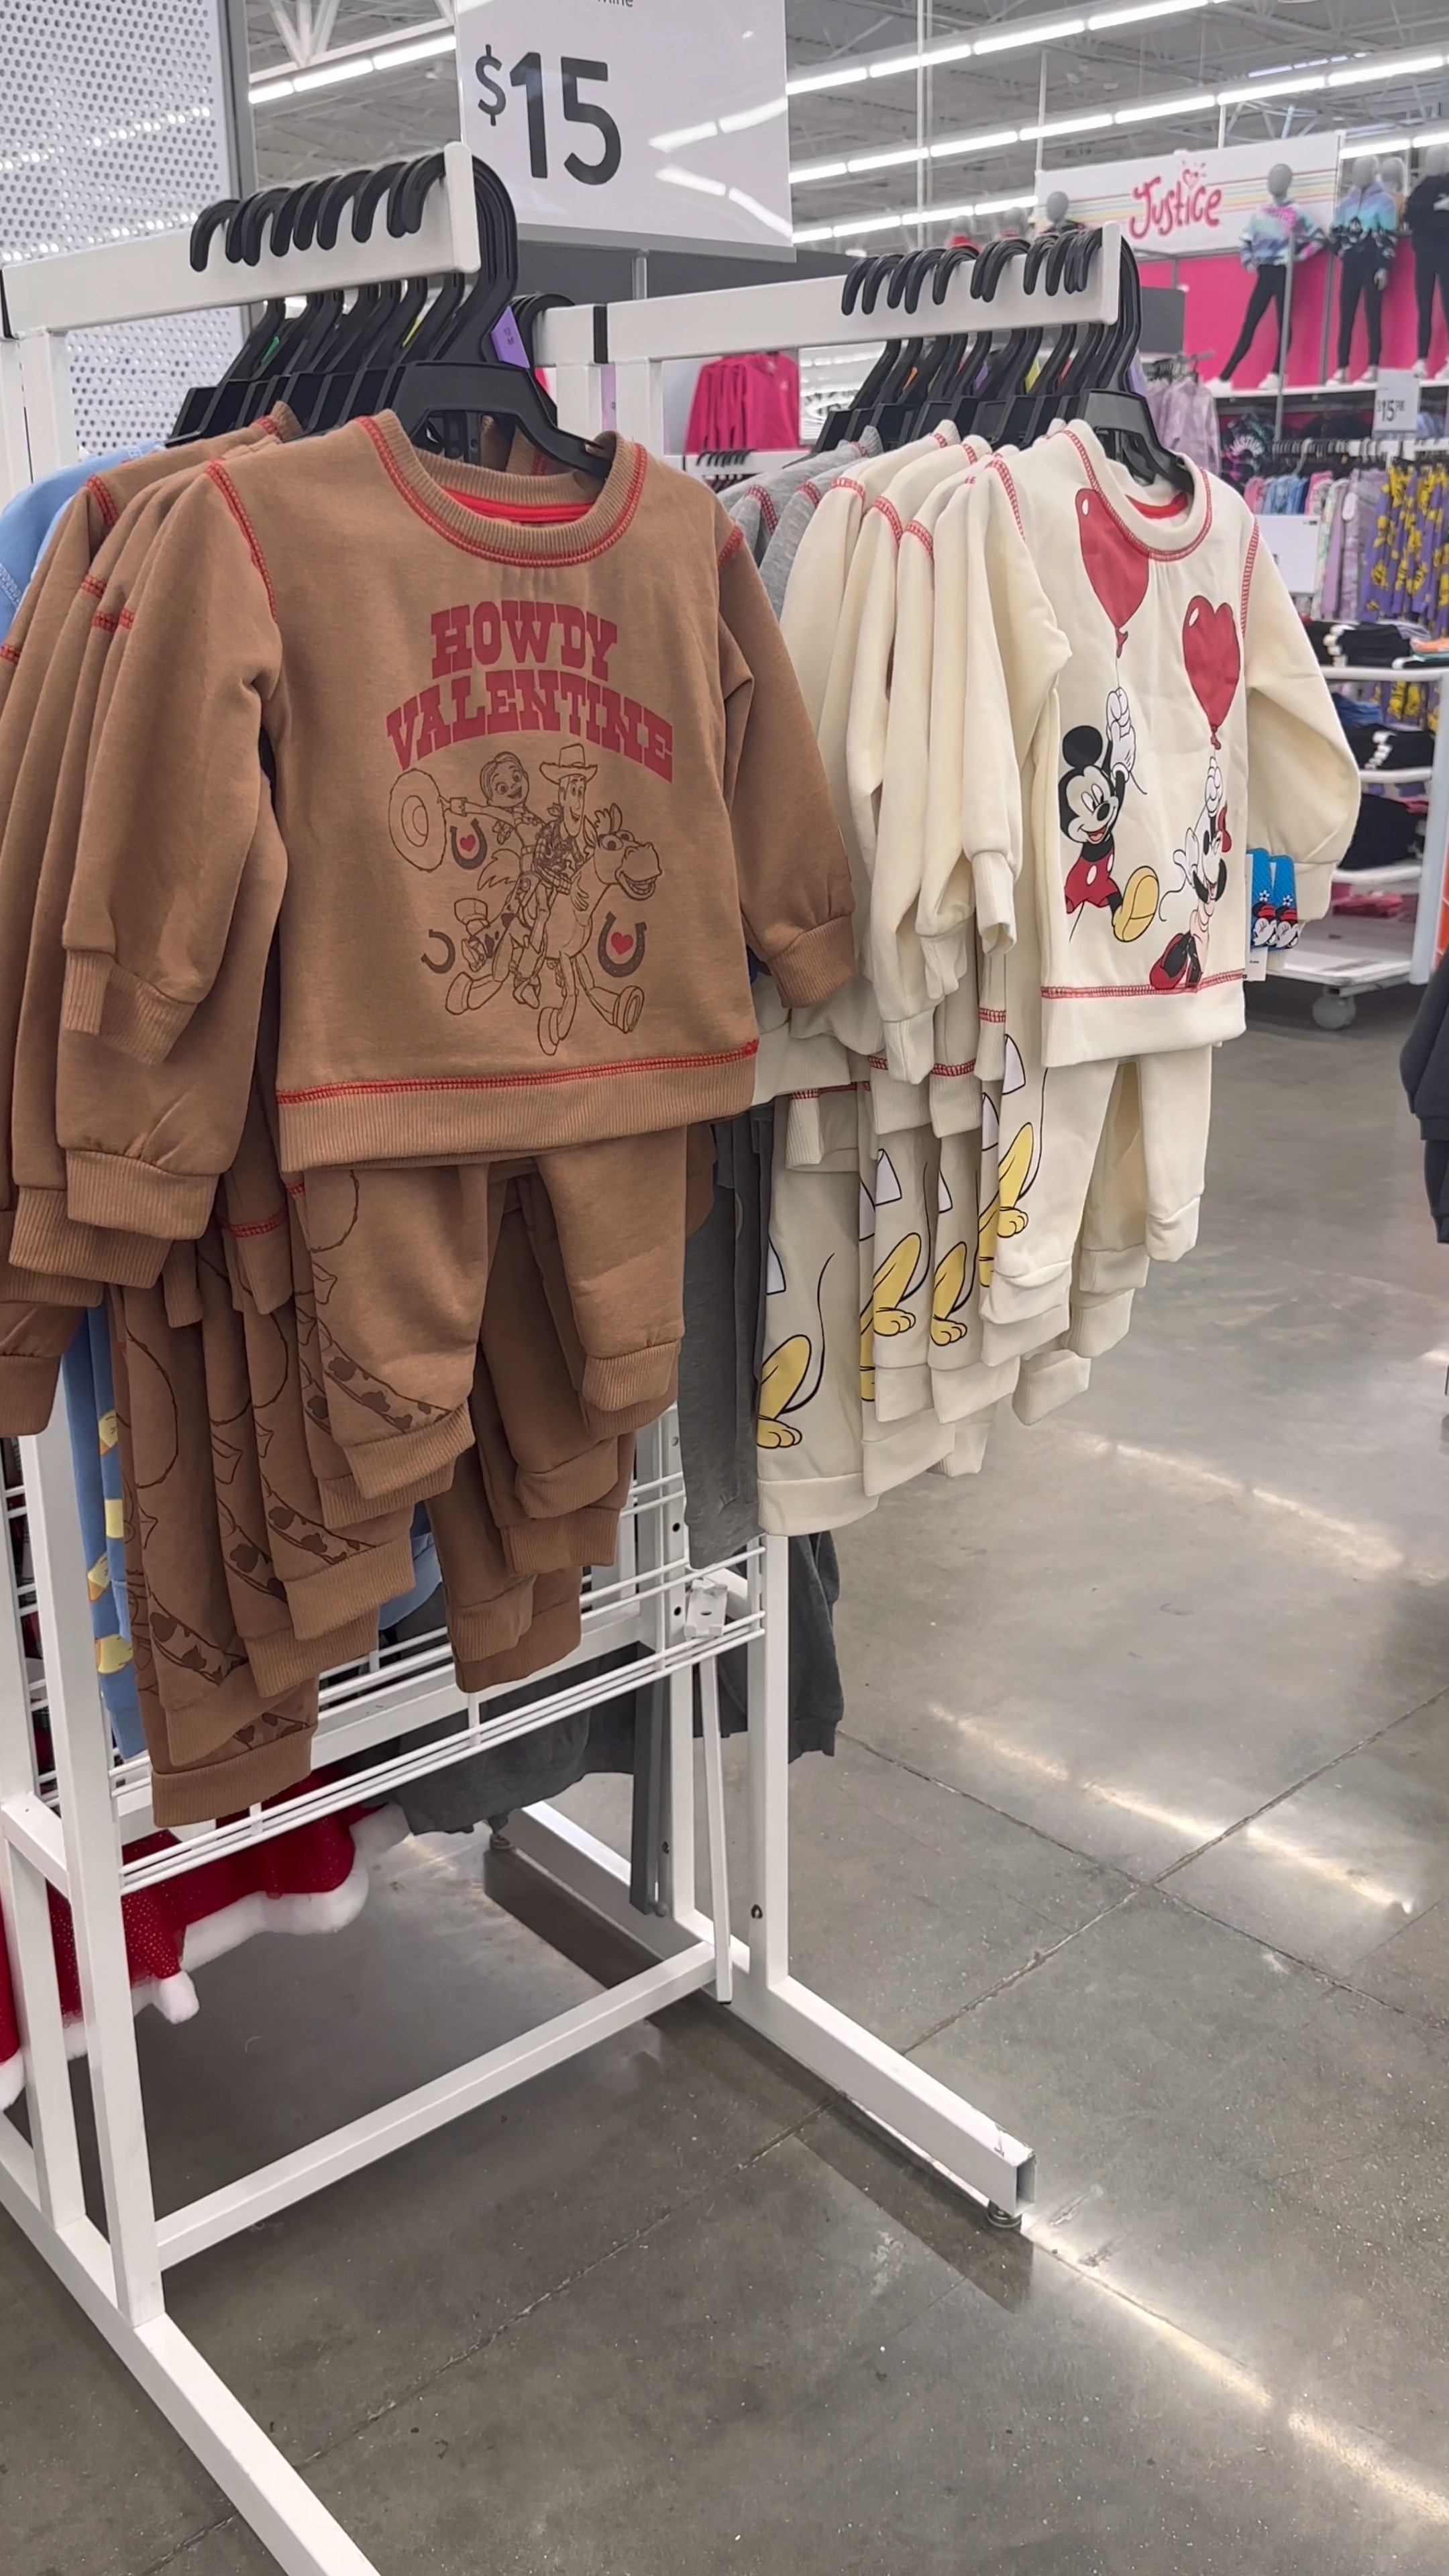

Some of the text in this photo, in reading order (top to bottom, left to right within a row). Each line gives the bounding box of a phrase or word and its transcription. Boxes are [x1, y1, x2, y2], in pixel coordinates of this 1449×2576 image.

[476, 44, 621, 185] $15
[1129, 168, 1222, 239] Justice
[431, 600, 617, 682] HOWDY
[386, 669, 673, 784] VALENTINE
